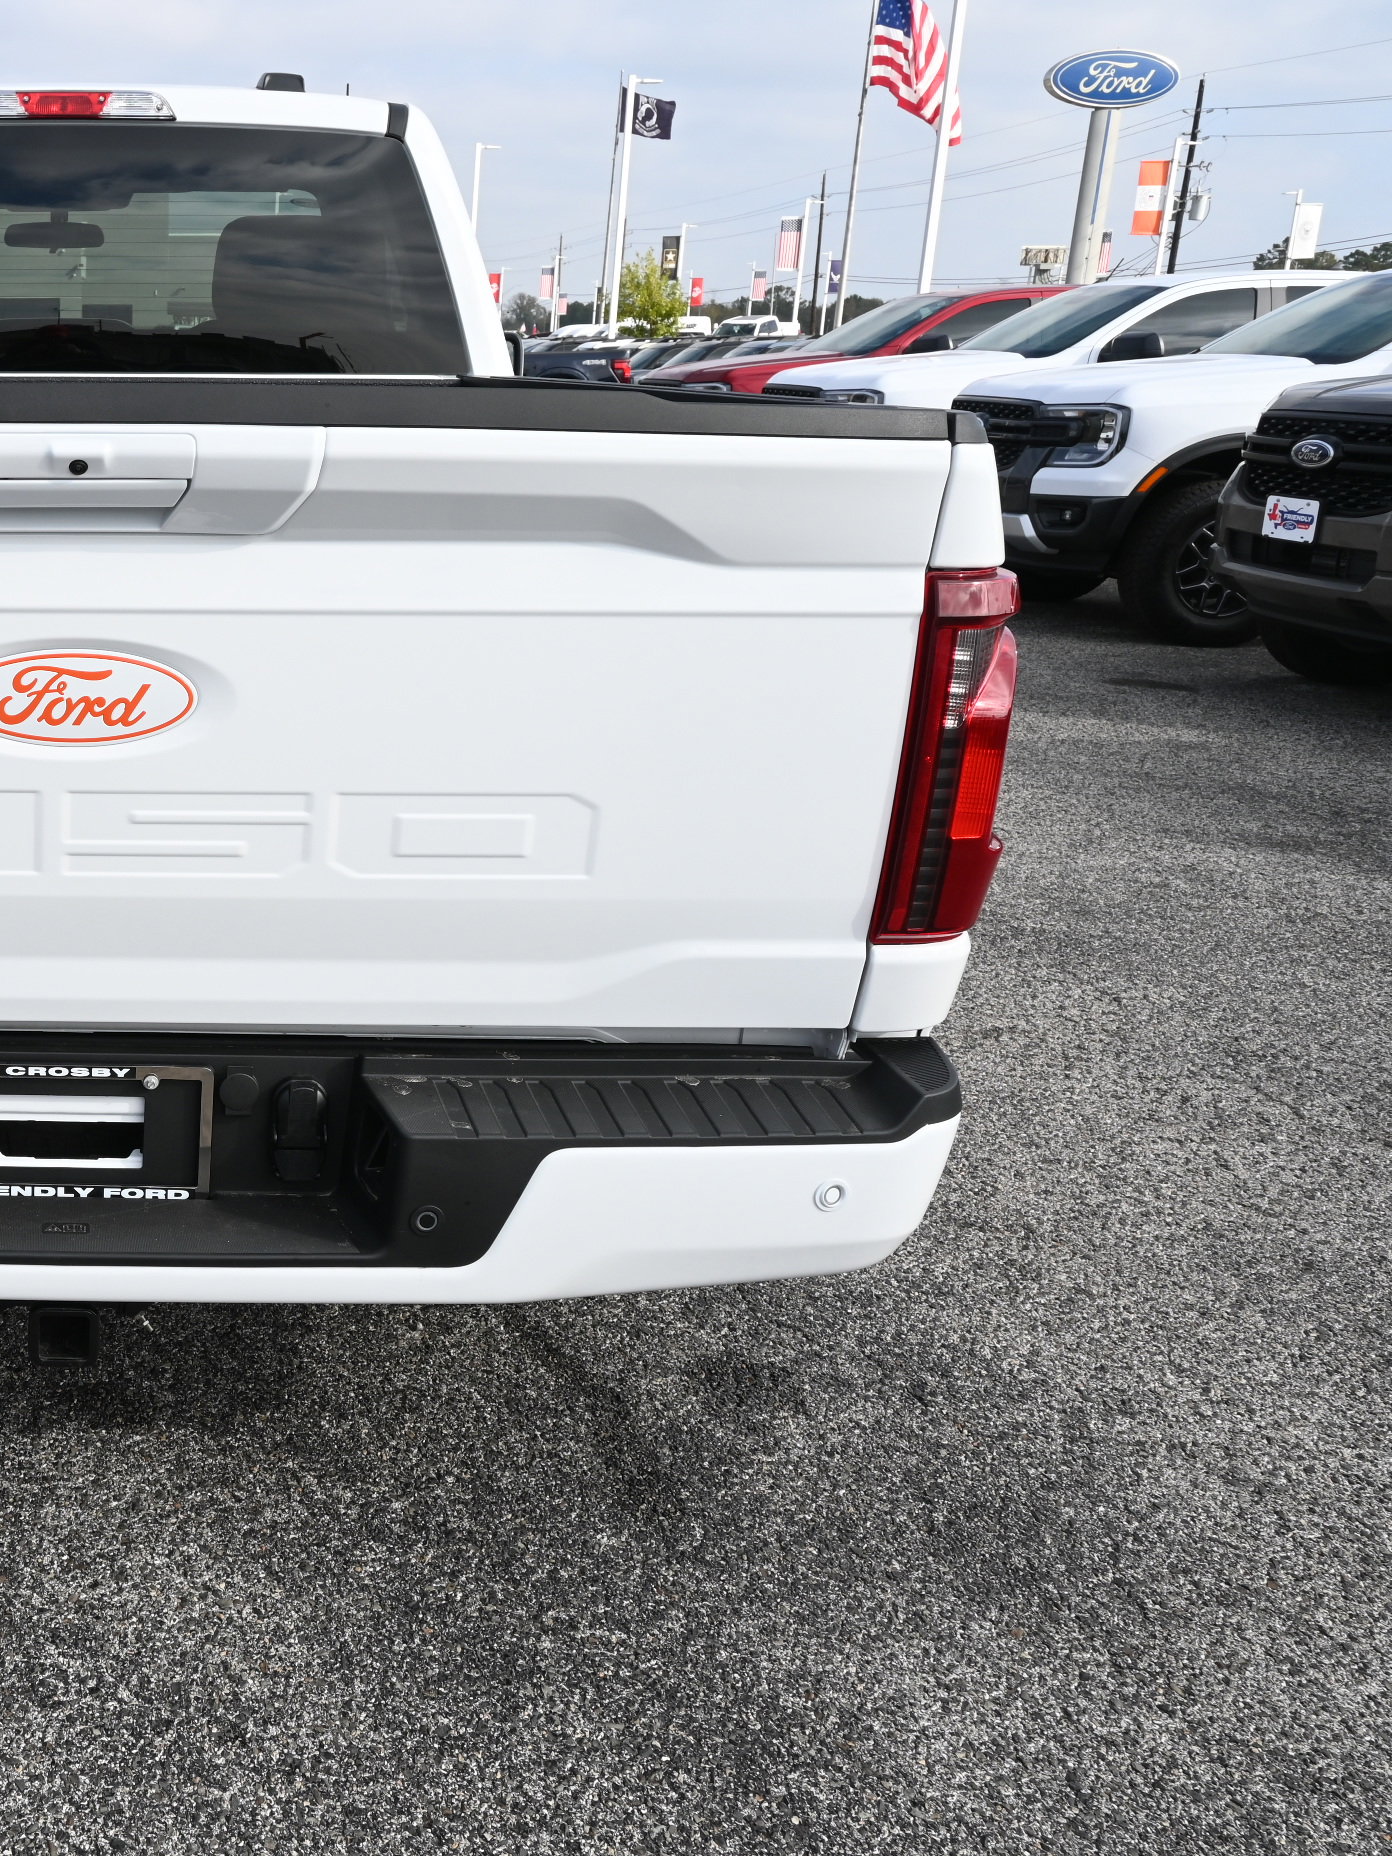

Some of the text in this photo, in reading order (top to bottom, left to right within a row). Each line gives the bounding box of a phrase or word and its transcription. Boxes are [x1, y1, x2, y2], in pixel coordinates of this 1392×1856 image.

[1079, 60, 1156, 93] Ford
[1298, 445, 1322, 461] Ford
[1283, 513, 1312, 522] FRIENDLY
[5, 1066, 131, 1078] CROSBY
[103, 1187, 190, 1201] FORD
